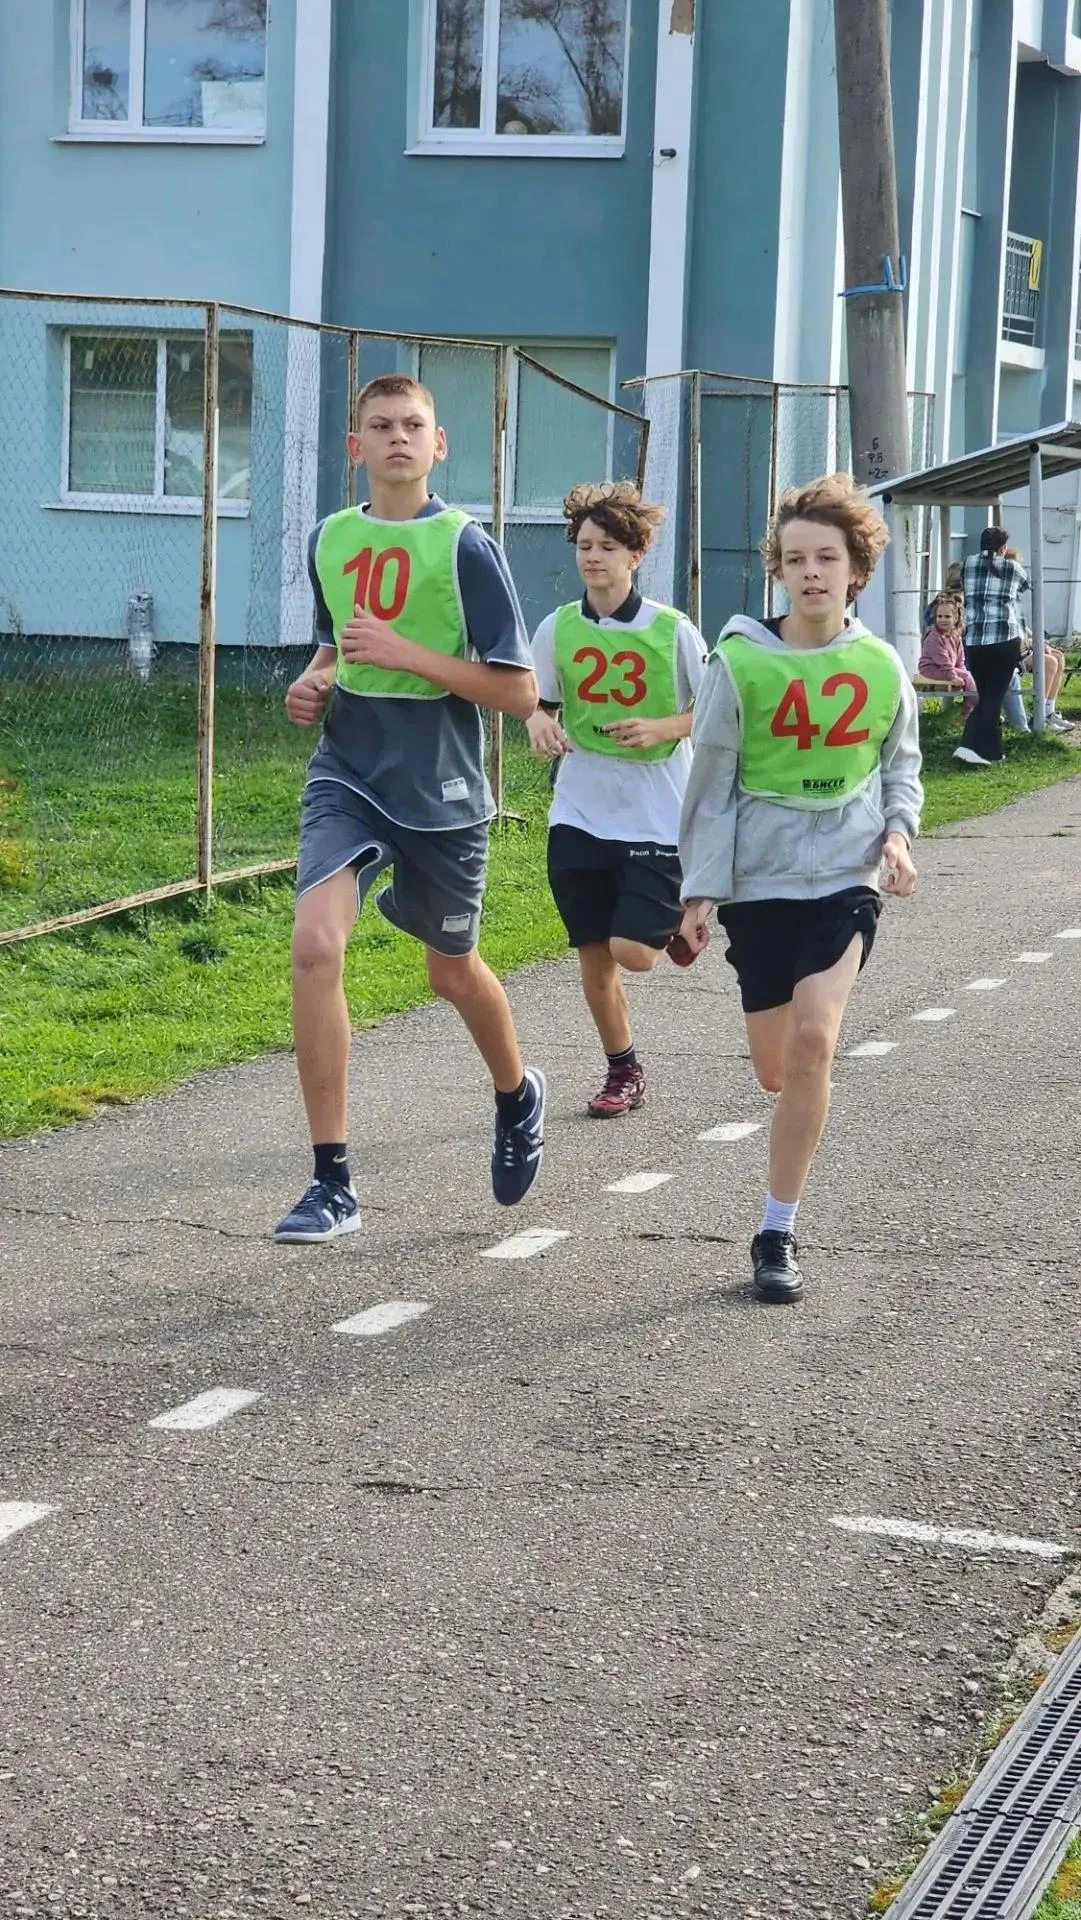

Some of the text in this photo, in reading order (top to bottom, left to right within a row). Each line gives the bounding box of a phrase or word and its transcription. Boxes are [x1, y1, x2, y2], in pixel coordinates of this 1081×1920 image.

[343, 547, 411, 621] 10
[573, 646, 647, 707] 23
[770, 672, 870, 751] 42
